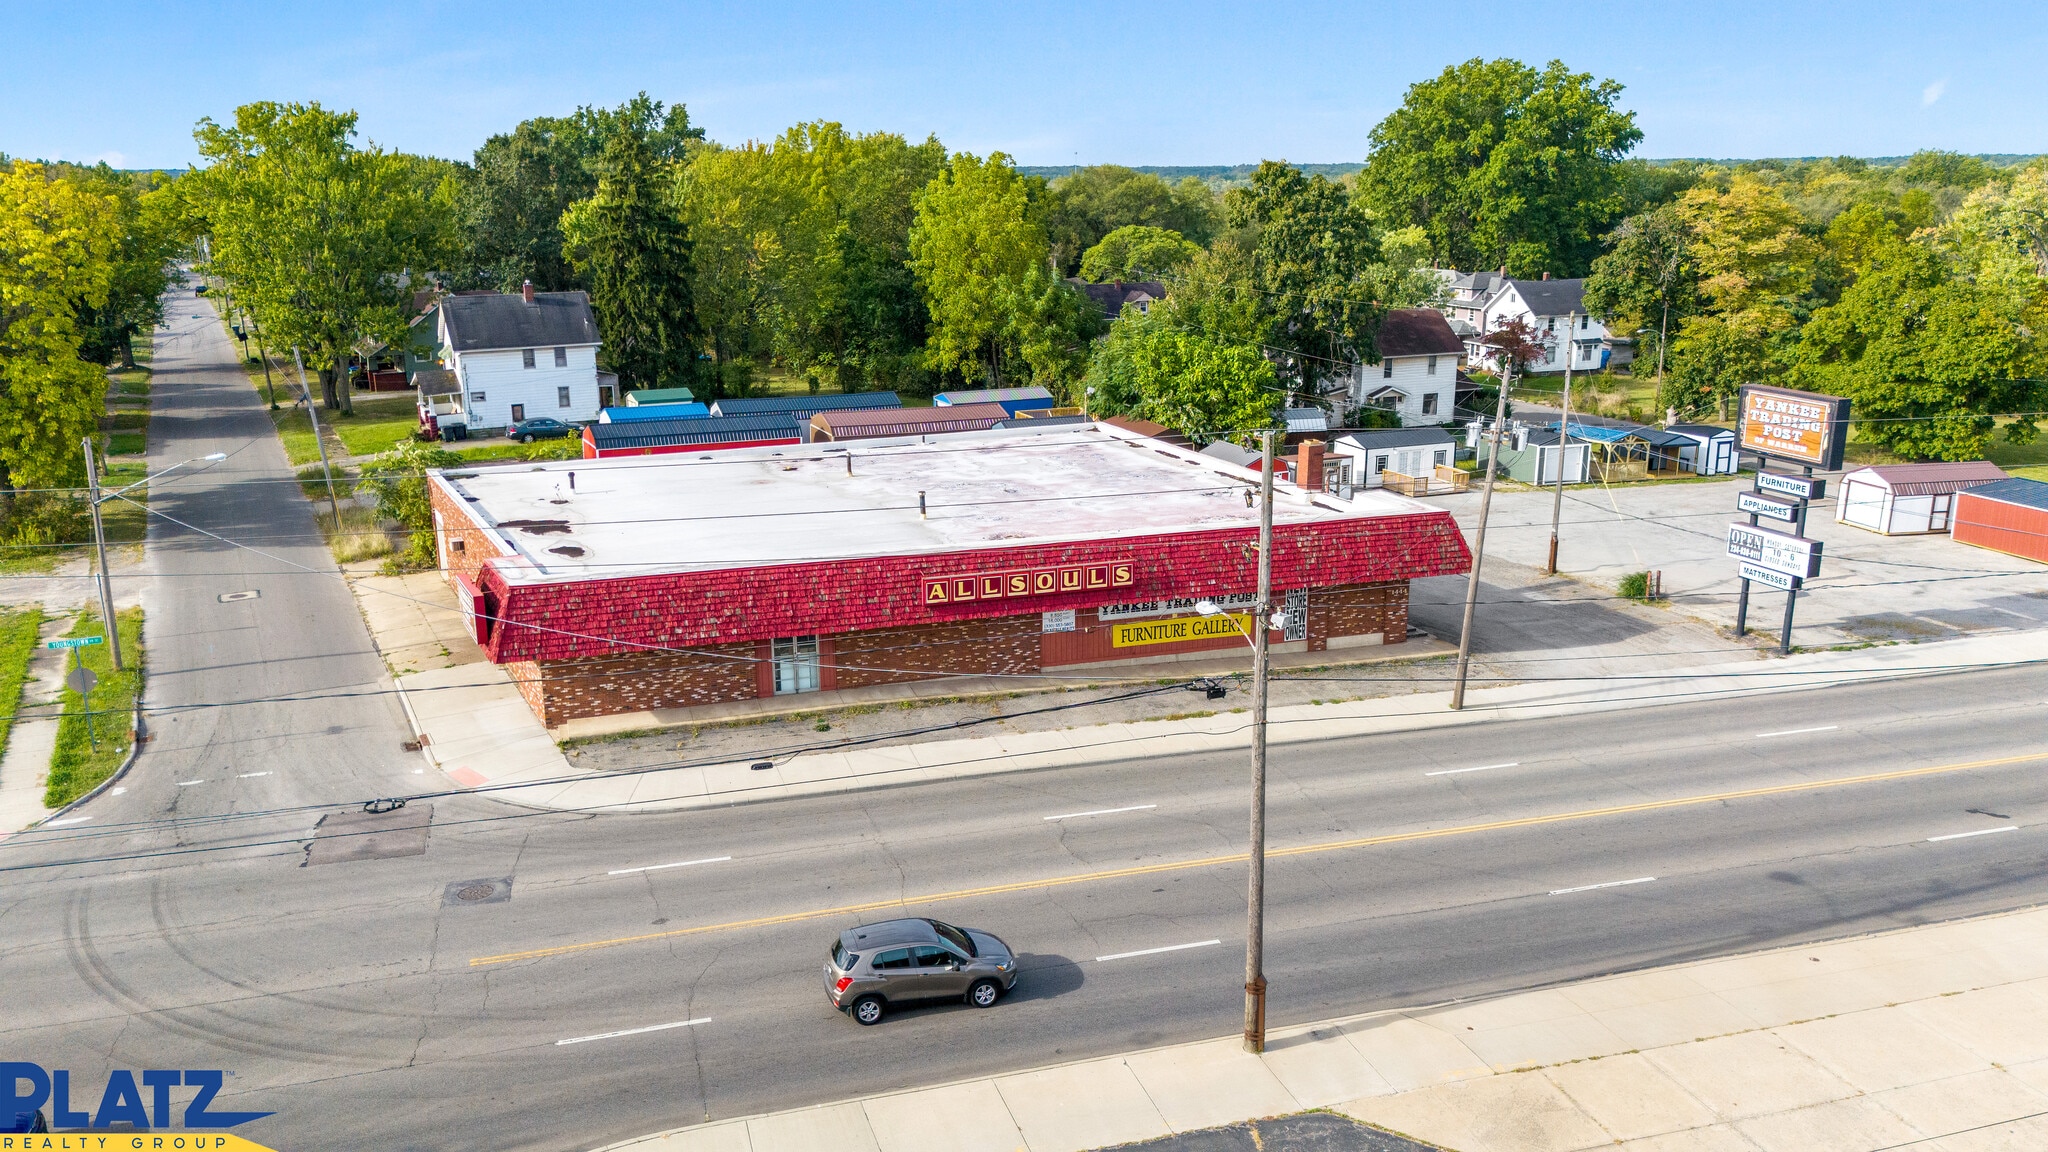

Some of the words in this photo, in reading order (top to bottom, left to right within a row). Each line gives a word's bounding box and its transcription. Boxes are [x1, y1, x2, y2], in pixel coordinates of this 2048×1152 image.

[1755, 397, 1820, 419] YANKEE
[1750, 409, 1821, 432] TRADING
[1754, 436, 1765, 444] OF
[1763, 424, 1802, 442] POST
[1761, 476, 1806, 493] FURNITURE
[1743, 499, 1787, 516] APPLIANCES
[1731, 530, 1763, 549] OPEN
[1773, 548, 1782, 557] 10
[1789, 553, 1795, 561] 6
[1743, 566, 1788, 586] MATTRESSES
[1102, 601, 1158, 615] YANKEE
[1165, 595, 1226, 609] TRANG
[1286, 594, 1306, 609] STORE
[1121, 622, 1187, 643] FURNITURE
[1192, 617, 1244, 636] GALLERY
[1285, 624, 1306, 640] OWNER
[52, 638, 89, 649] YOUNGSTOWN
